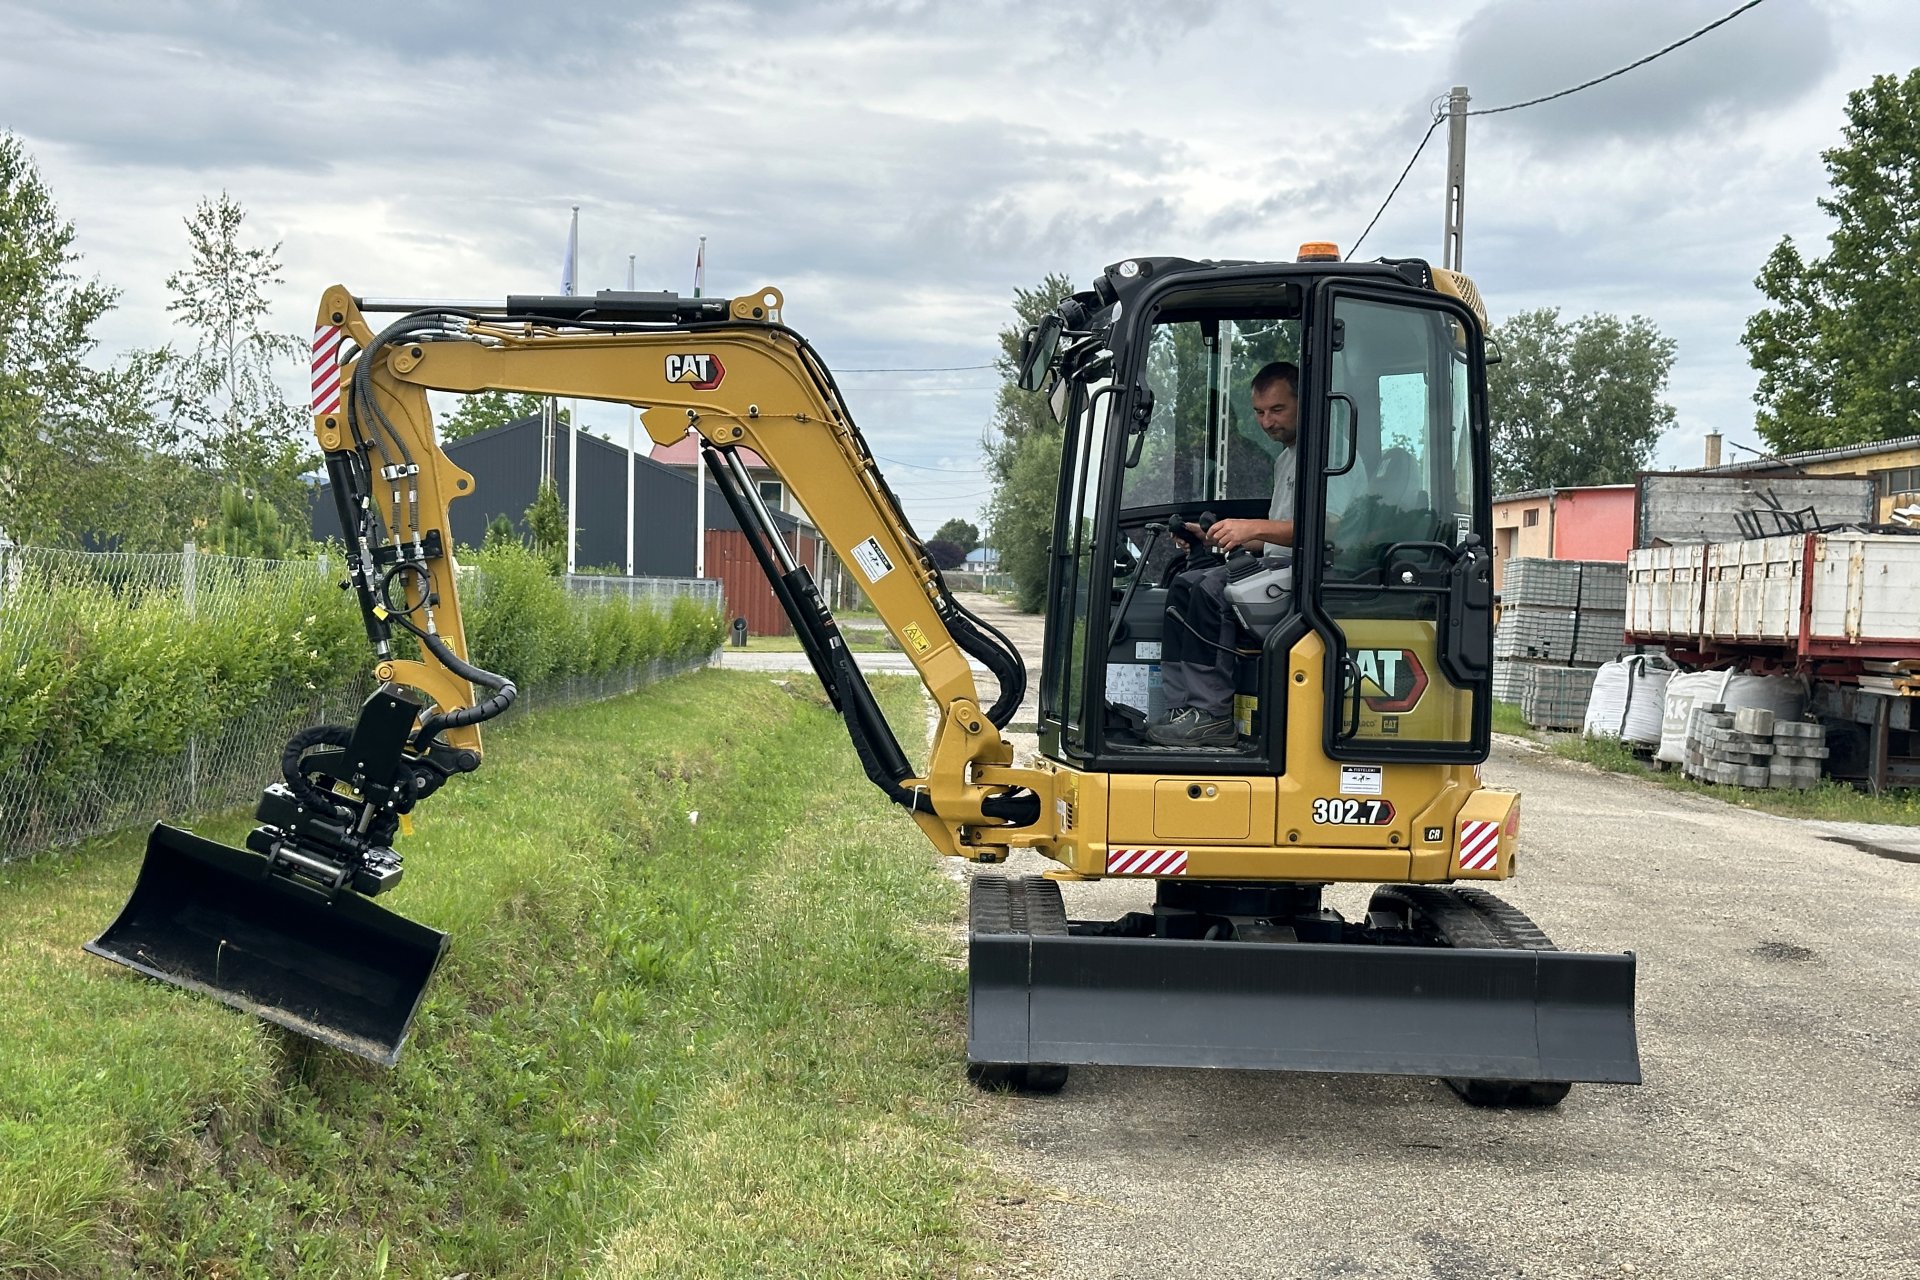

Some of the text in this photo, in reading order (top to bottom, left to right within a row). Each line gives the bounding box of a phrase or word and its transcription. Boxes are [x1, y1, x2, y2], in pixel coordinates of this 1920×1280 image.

[666, 355, 710, 382] CAT
[1345, 650, 1402, 697] AT
[1313, 799, 1382, 824] 302.7
[1428, 829, 1441, 840] CR
